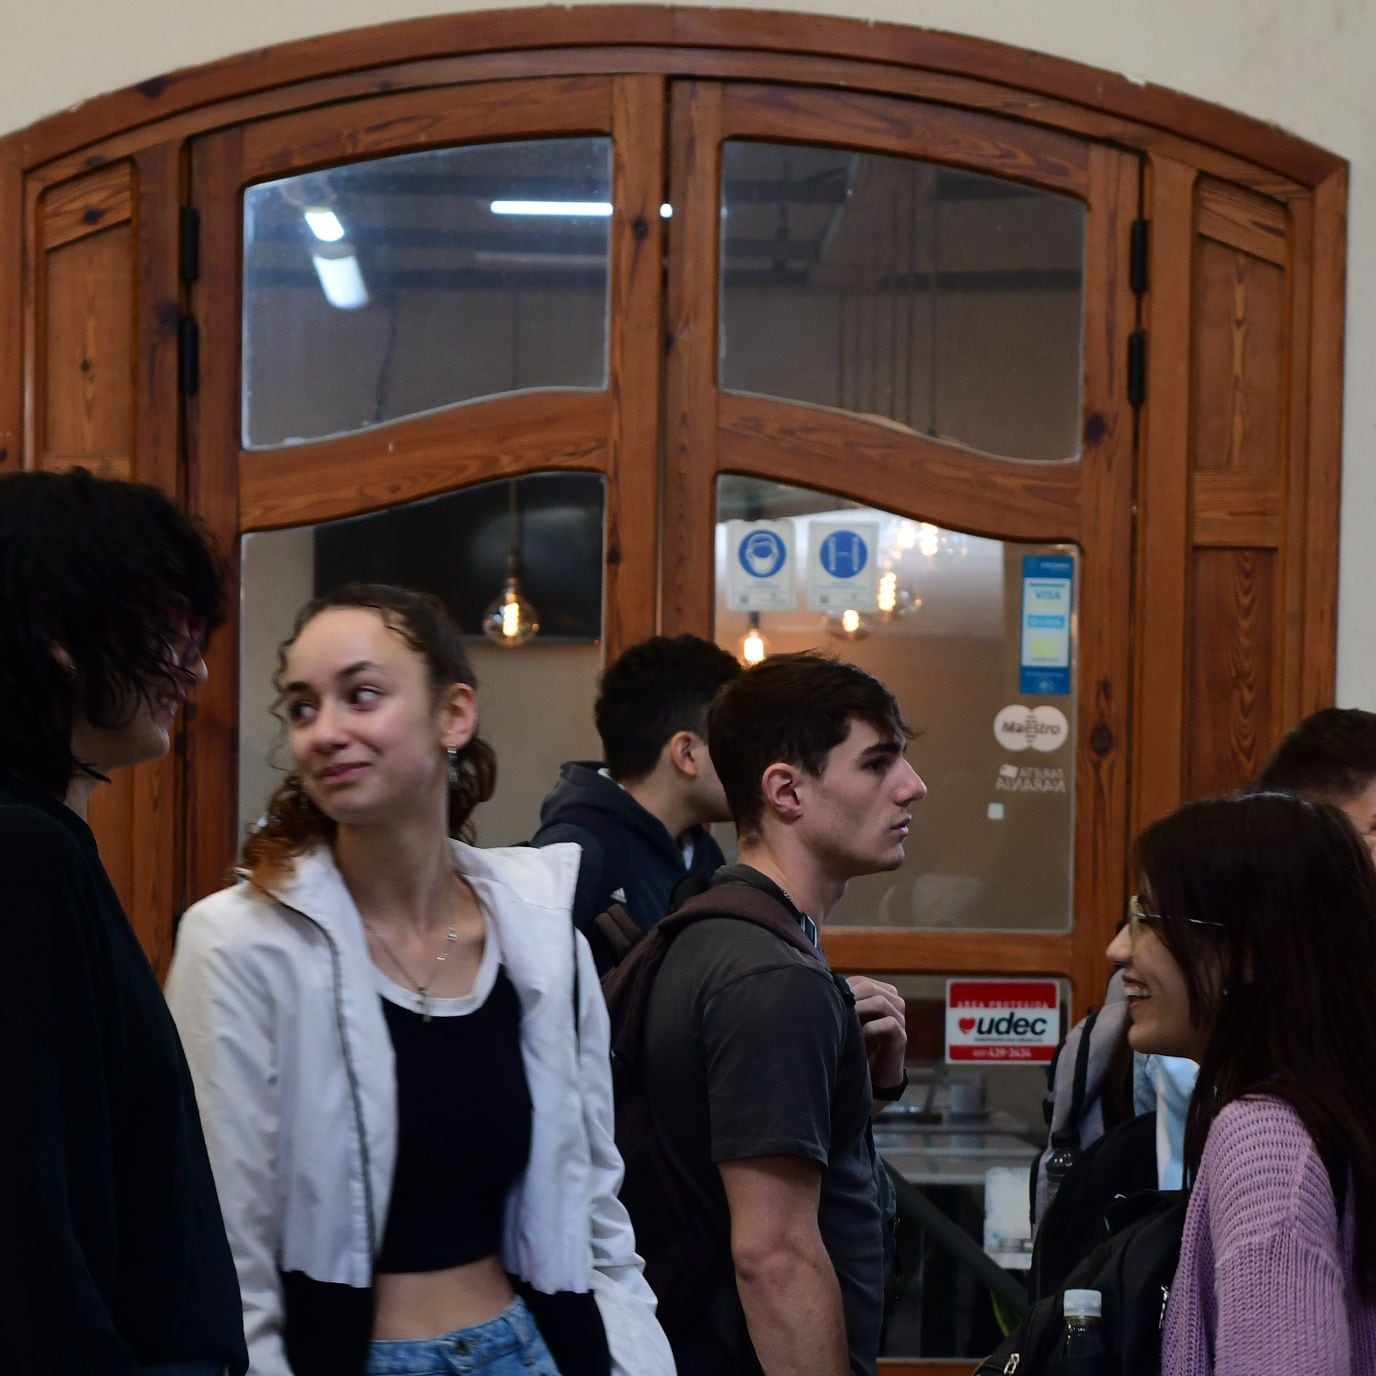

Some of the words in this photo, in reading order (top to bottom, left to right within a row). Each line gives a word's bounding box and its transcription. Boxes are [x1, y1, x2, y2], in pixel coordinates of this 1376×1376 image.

[1033, 590, 1062, 600] VISA
[1001, 720, 1062, 736] Maestro
[976, 1011, 1048, 1036] udec
